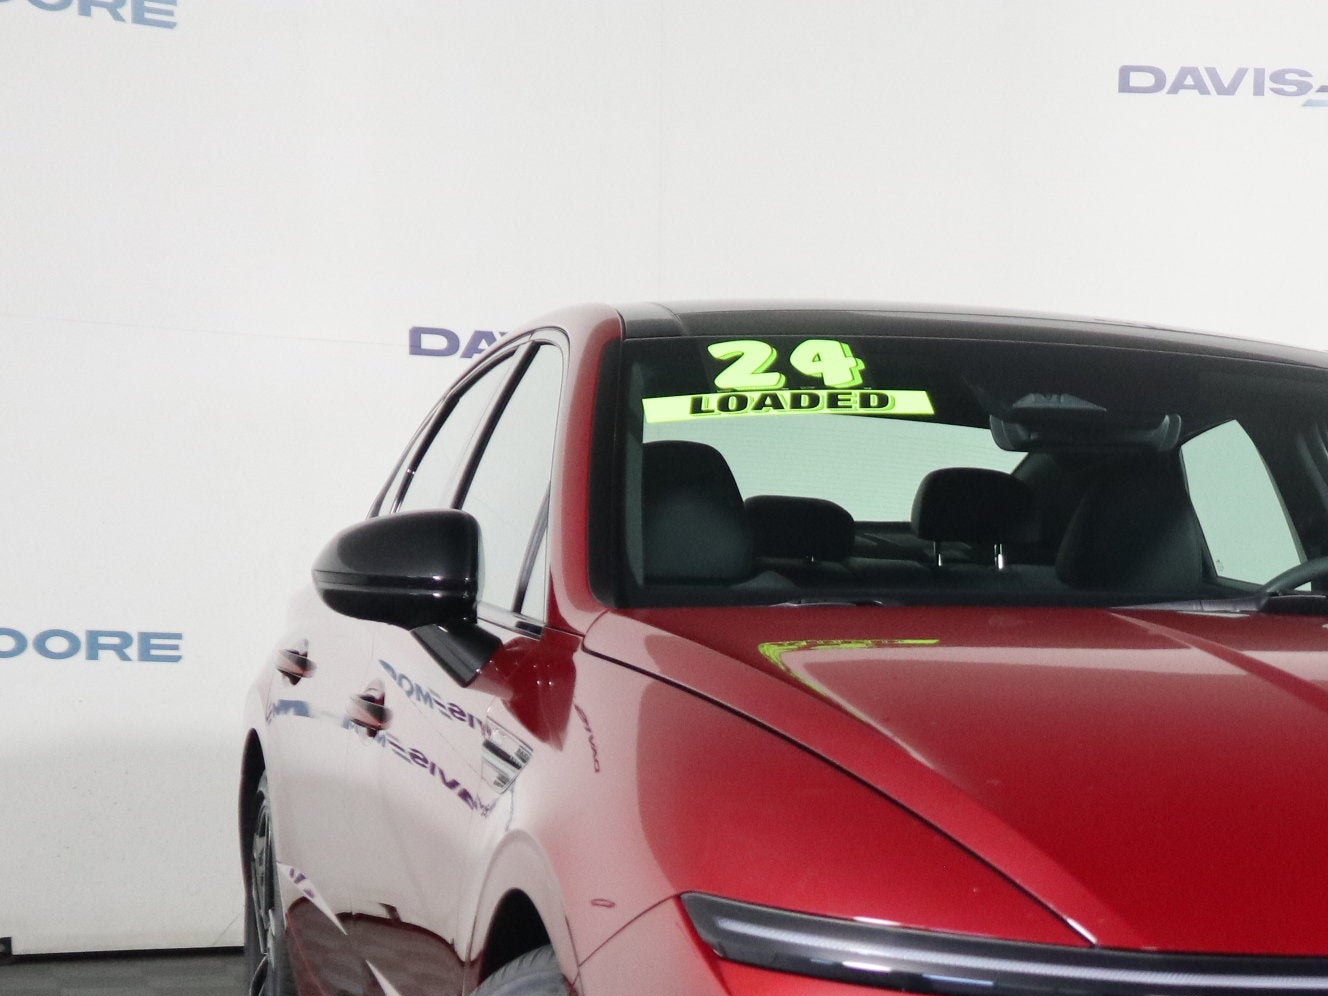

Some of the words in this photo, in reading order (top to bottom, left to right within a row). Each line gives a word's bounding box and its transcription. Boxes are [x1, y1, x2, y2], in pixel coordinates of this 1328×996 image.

[1118, 64, 1314, 97] DAVIS
[707, 339, 865, 390] 24
[689, 391, 892, 416] LOADED
